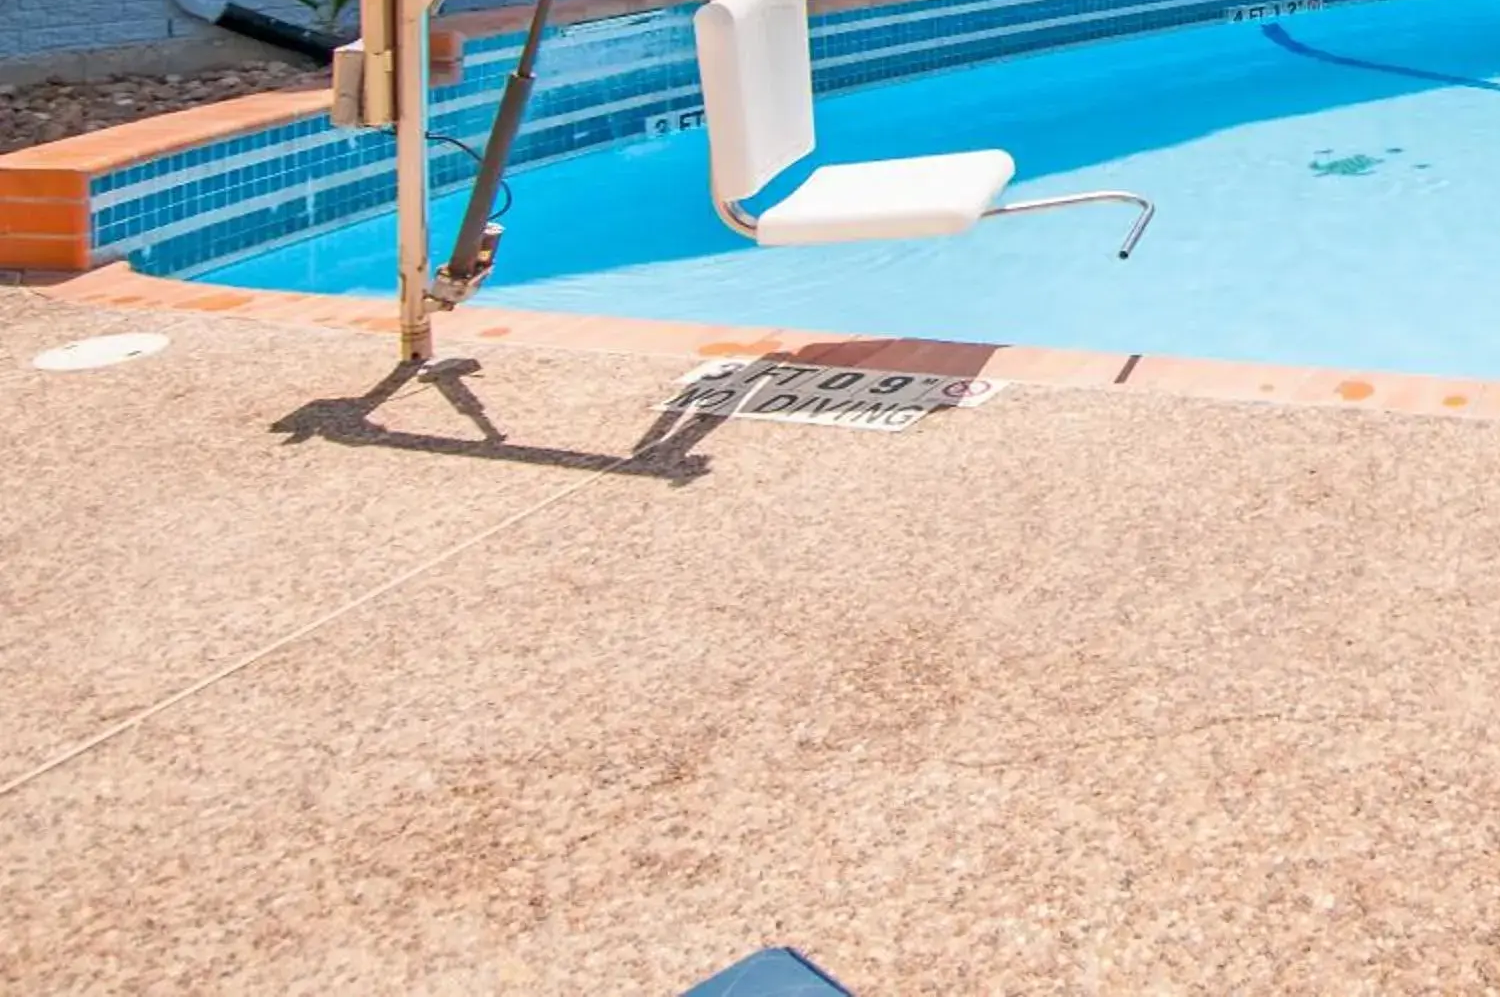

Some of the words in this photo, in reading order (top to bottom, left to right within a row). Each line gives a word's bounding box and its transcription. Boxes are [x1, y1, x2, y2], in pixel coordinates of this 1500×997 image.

[1249, 6, 1264, 20] FT
[700, 362, 744, 381] 3
[744, 365, 821, 386] FT
[665, 386, 736, 409] NO
[753, 393, 928, 426] DIVING
